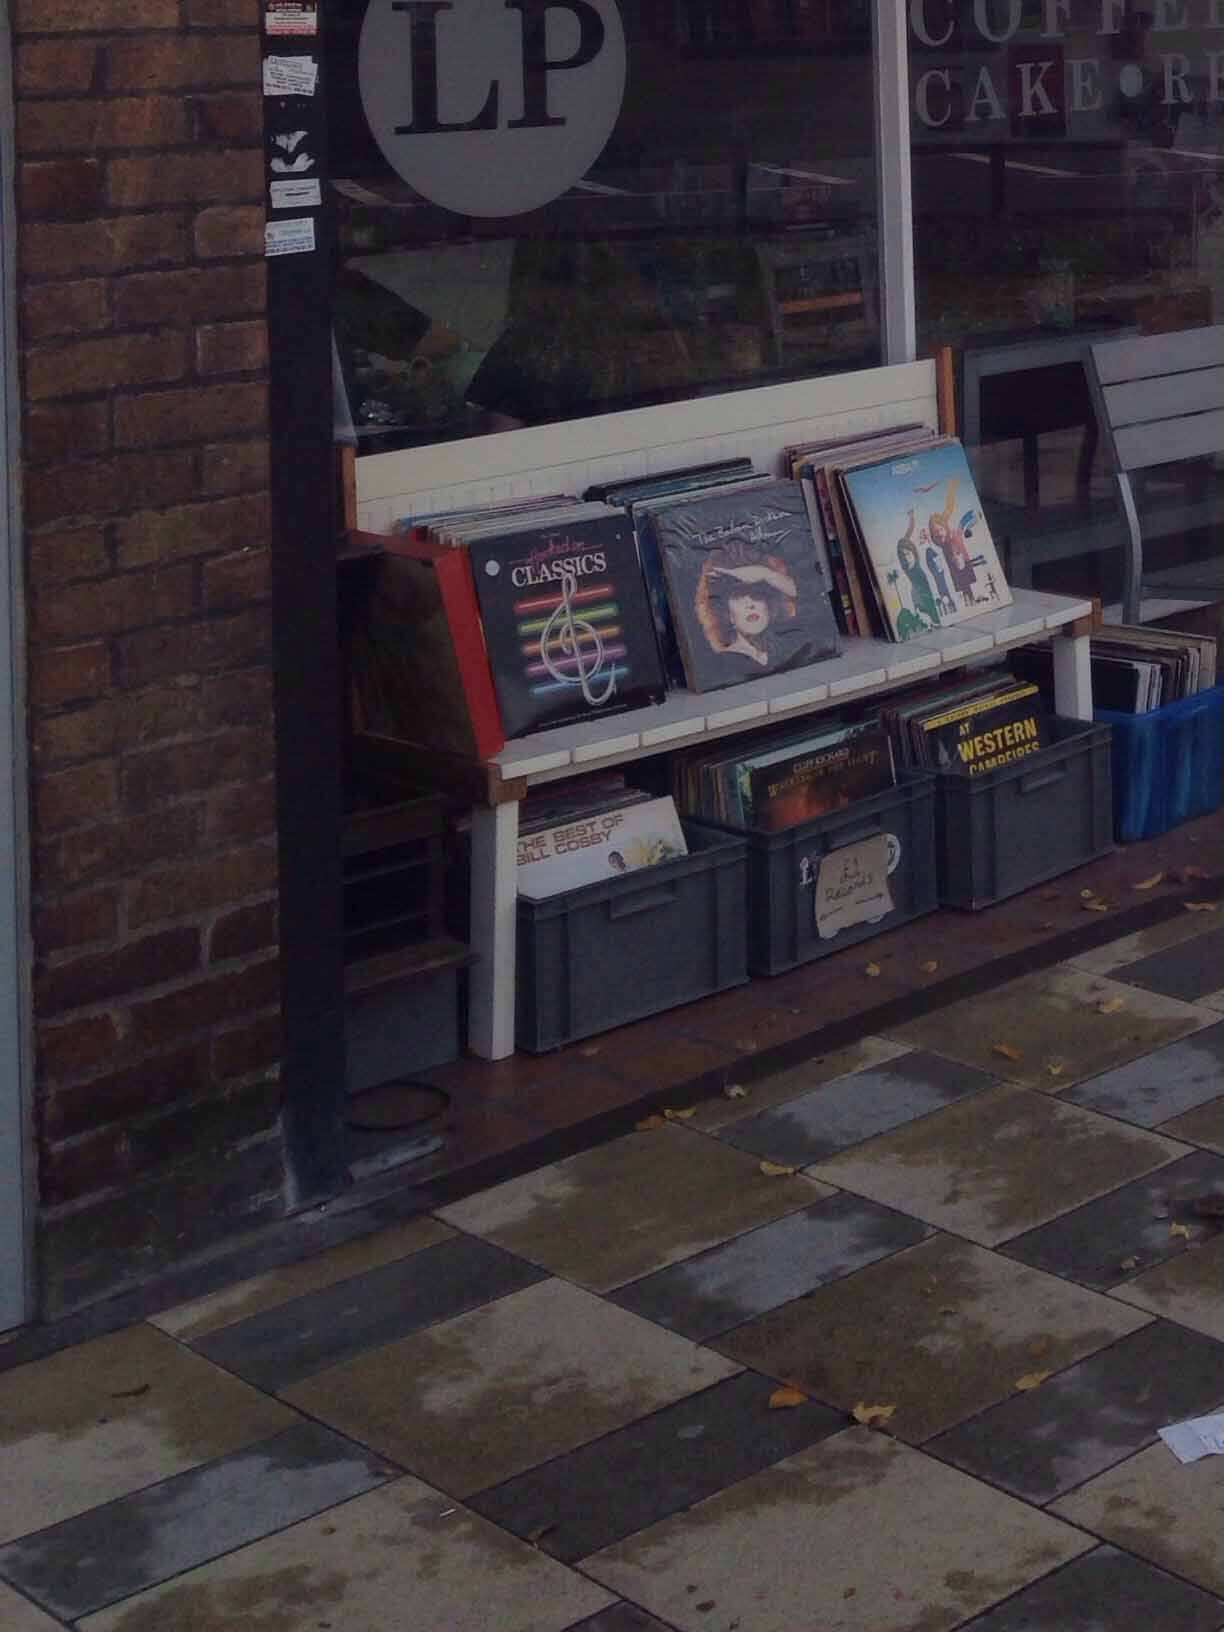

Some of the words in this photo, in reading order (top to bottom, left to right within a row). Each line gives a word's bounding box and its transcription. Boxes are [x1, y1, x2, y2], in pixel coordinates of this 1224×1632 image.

[915, 59, 1100, 127] CAKE
[511, 552, 607, 588] CLASSICS
[958, 716, 1038, 763] WESTERN
[959, 721, 971, 736] AT
[516, 835, 547, 854] THE
[553, 820, 597, 844] BEST
[601, 814, 625, 829] OF
[516, 848, 551, 867] BILL
[555, 830, 612, 855] COSBY
